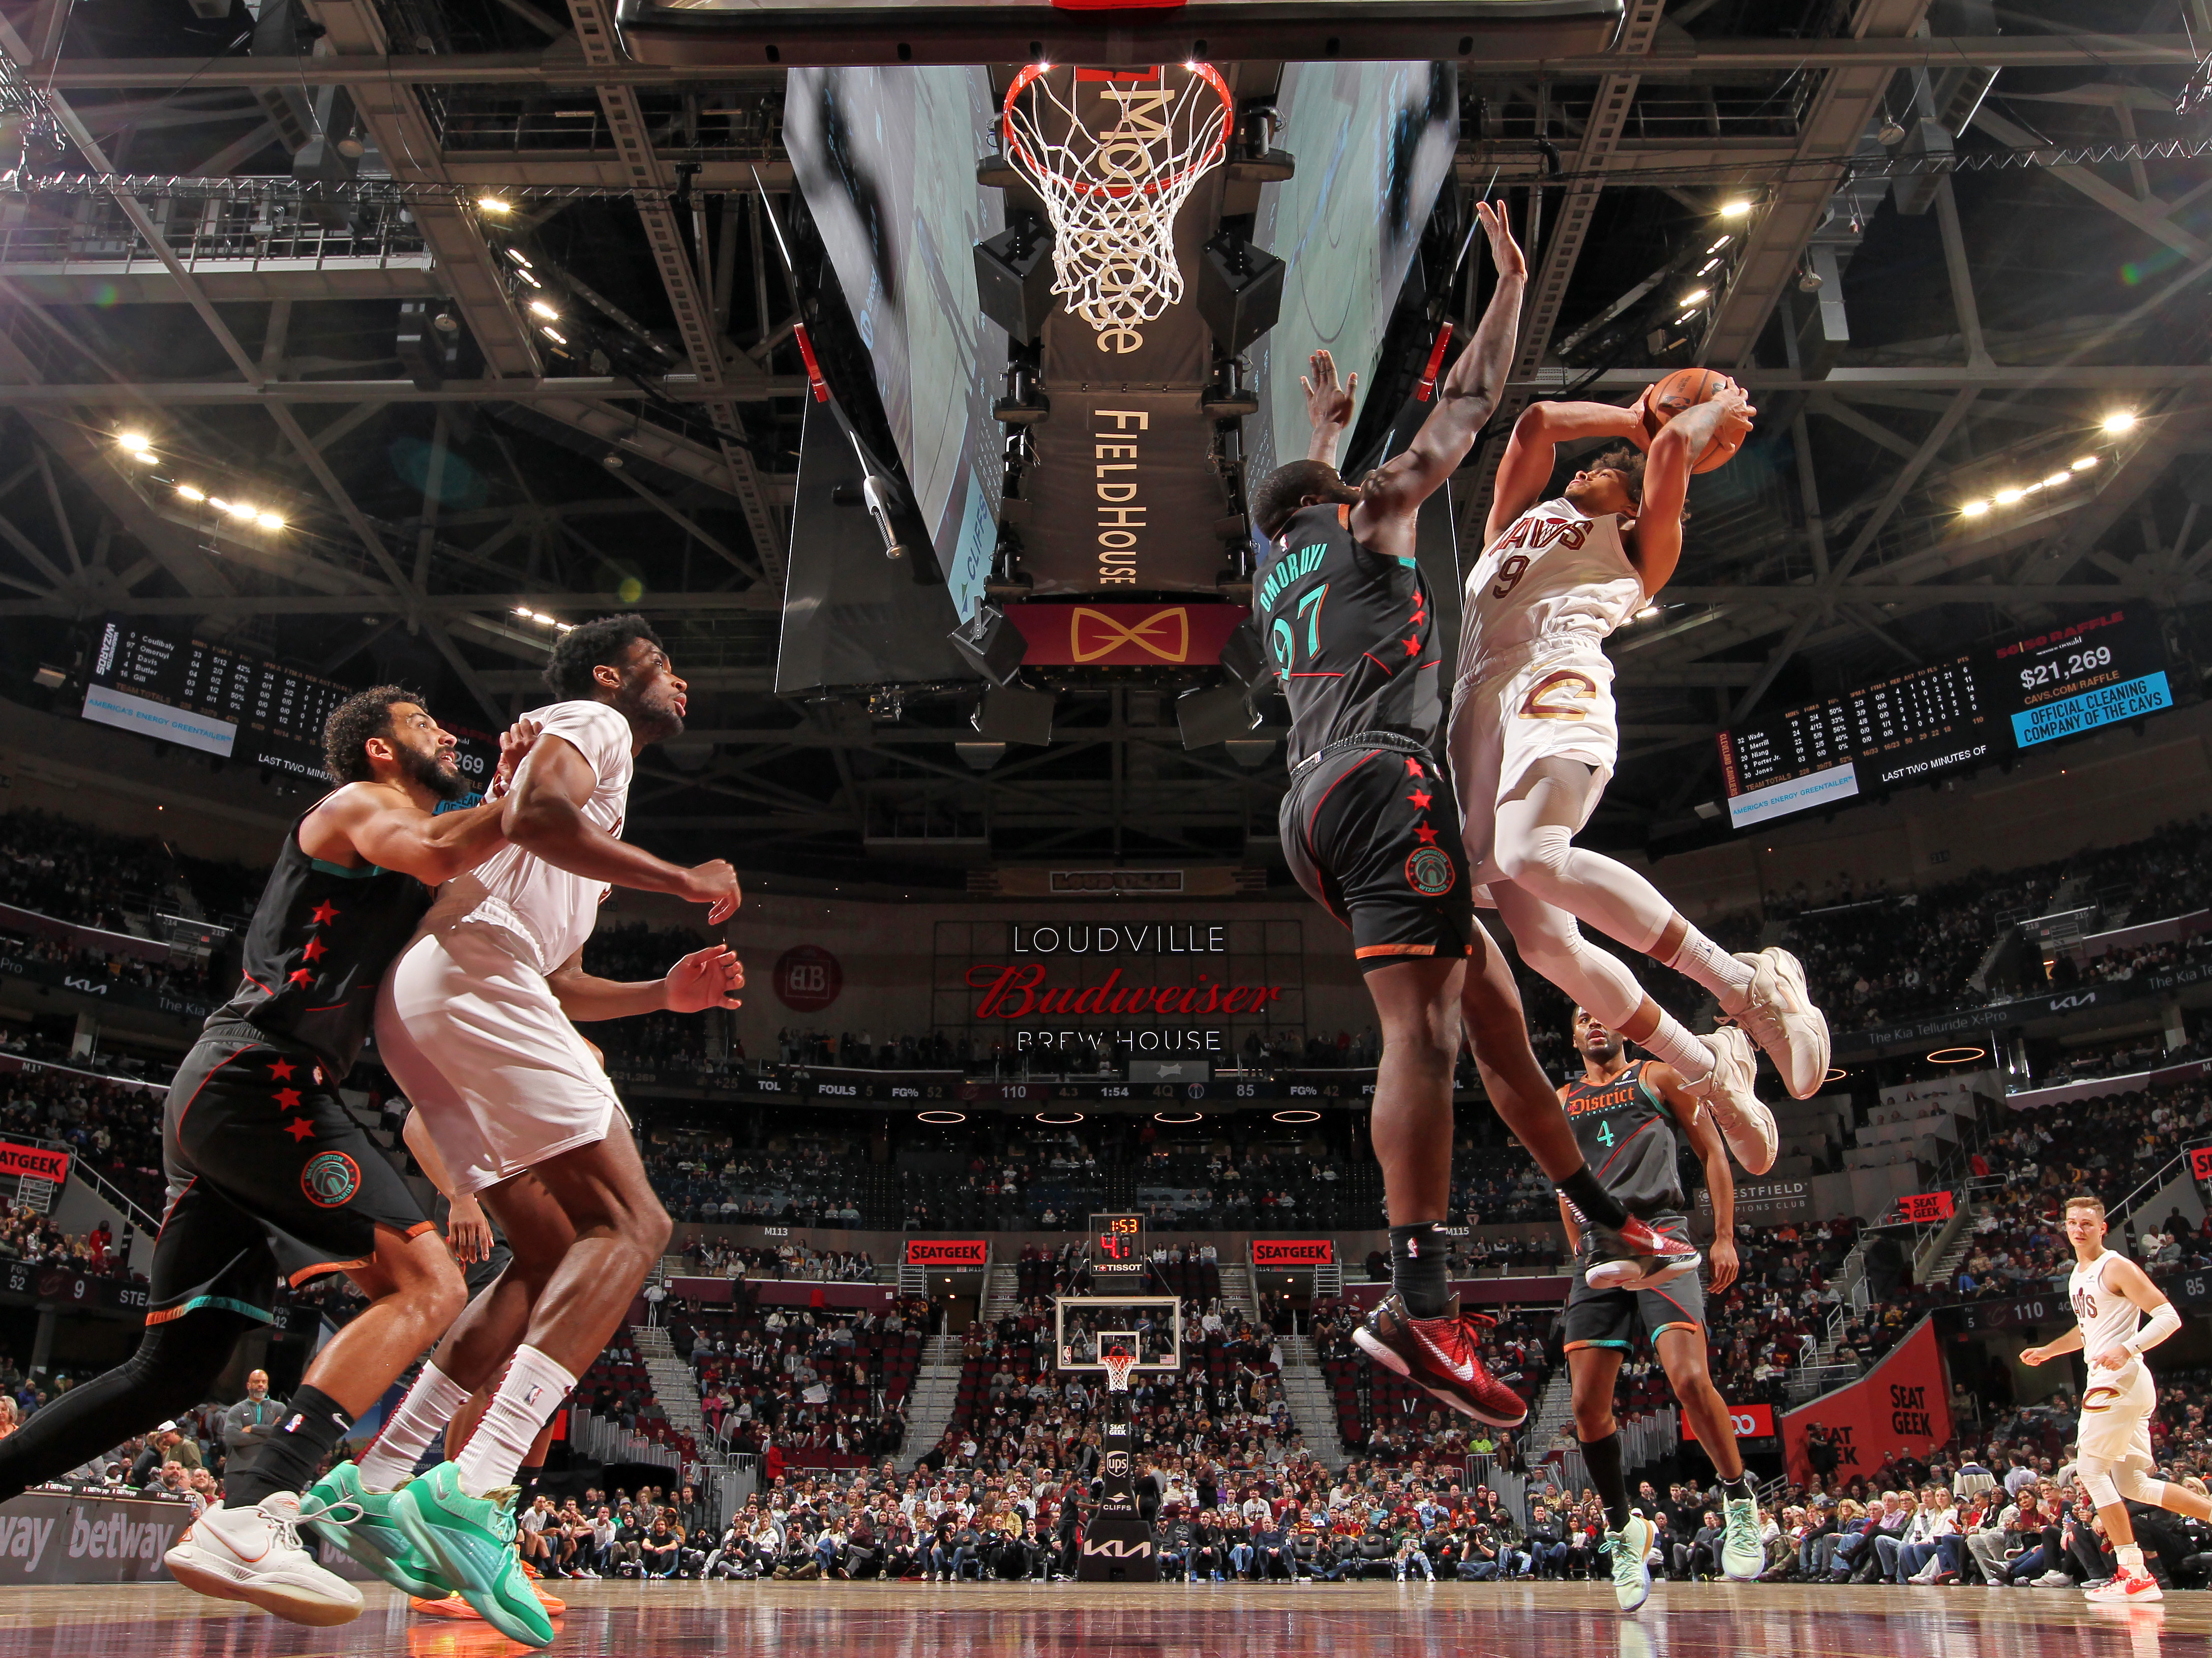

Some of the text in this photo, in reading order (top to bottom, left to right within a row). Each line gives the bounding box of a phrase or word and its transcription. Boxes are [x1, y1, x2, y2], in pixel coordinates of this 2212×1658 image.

[1095, 409, 1148, 584] FIELDHOUSE
[968, 494, 988, 581] CLIFFS
[1489, 517, 1594, 557] AVS
[1260, 543, 1327, 612] OMORUYI
[1492, 555, 1531, 599] 9
[1273, 583, 1330, 681] 97
[96, 623, 115, 675] WIZARDS
[142, 636, 174, 651] Coulibaly
[135, 664, 158, 676] Butler
[137, 655, 157, 666] Davis
[2020, 646, 2111, 690] $21,269
[133, 674, 146, 682] Gill
[88, 698, 170, 726] AMERICA'S ENERGY
[2030, 680, 2147, 726] OFFICIAL CLEANING
[1748, 732, 1764, 741] Wade
[1829, 706, 1842, 715] 50%
[2023, 691, 2163, 743] COMPANY OF THE CAVS
[1750, 739, 1769, 750] Merrill
[1810, 722, 1823, 731] 4/12
[1719, 733, 1732, 766] CLEVELAND
[1752, 749, 1769, 759] Niang
[258, 753, 305, 773] LAST TWO
[1753, 758, 1772, 767] Porter
[1755, 766, 1773, 776] Jones
[1882, 745, 1986, 781] LAST TWO MINUTES OF
[1726, 766, 1738, 797] CAVALIERS
[1745, 773, 1791, 791] TEAM TOTALS
[1733, 800, 1769, 815] AMERICA'S
[1771, 792, 1798, 805] ENERGY
[1412, 850, 1447, 862] WASHINGTON
[1419, 884, 1447, 892] WIZARDS
[1015, 925, 1224, 953] LOUDVILLE
[0, 957, 22, 974] Pro
[2150, 976, 2173, 989] The
[2177, 969, 2196, 983] Kia
[965, 963, 1280, 1017] Budweiser
[159, 997, 205, 1016] The Kia
[1869, 1011, 2007, 1045] The Kia Telluride X-Pro
[1117, 1030, 1220, 1051] HOUSE
[758, 1081, 781, 1091] TOL
[819, 1084, 856, 1096] FOULS
[892, 1087, 942, 1098] FG% 52
[1002, 1086, 1026, 1098] 110
[1101, 1087, 1129, 1097] 1:54
[1153, 1085, 1174, 1097] 4Q
[1237, 1084, 1254, 1097] 85
[1291, 1086, 1317, 1096] FG%
[1569, 1086, 1636, 1116] District
[1587, 1102, 1634, 1117] COLUMBIA
[1596, 1120, 1615, 1148] 4
[0, 1151, 63, 1177] ATGEEK
[306, 1155, 344, 1180] WASHINGTON
[324, 1184, 354, 1204] WIZARDS
[1733, 1183, 1803, 1199] ESTFIELD
[1776, 1200, 1805, 1210] CLUB
[1914, 1196, 1938, 1208] SEAT
[1914, 1207, 1940, 1218] GEEK
[764, 1227, 788, 1236] M113
[1111, 1219, 1138, 1233] 1:53
[1446, 1226, 1469, 1236] M115
[911, 1245, 981, 1260] SEATGEEK
[1257, 1244, 1328, 1260] SEATGEEK
[10, 1275, 25, 1291] 52
[74, 1280, 85, 1299] 9
[2186, 1277, 2205, 1296] 85
[119, 1290, 151, 1307] STEA
[2072, 1294, 2098, 1318] AVS
[2014, 1302, 2043, 1319] 110
[1968, 1317, 1975, 1328] 5
[1891, 1383, 1925, 1409] SEAT
[1892, 1411, 1933, 1438] GEEK
[1108, 1458, 1127, 1473] ups
[0, 1505, 174, 1573] way betway
[1084, 1539, 1151, 1558] KIA
